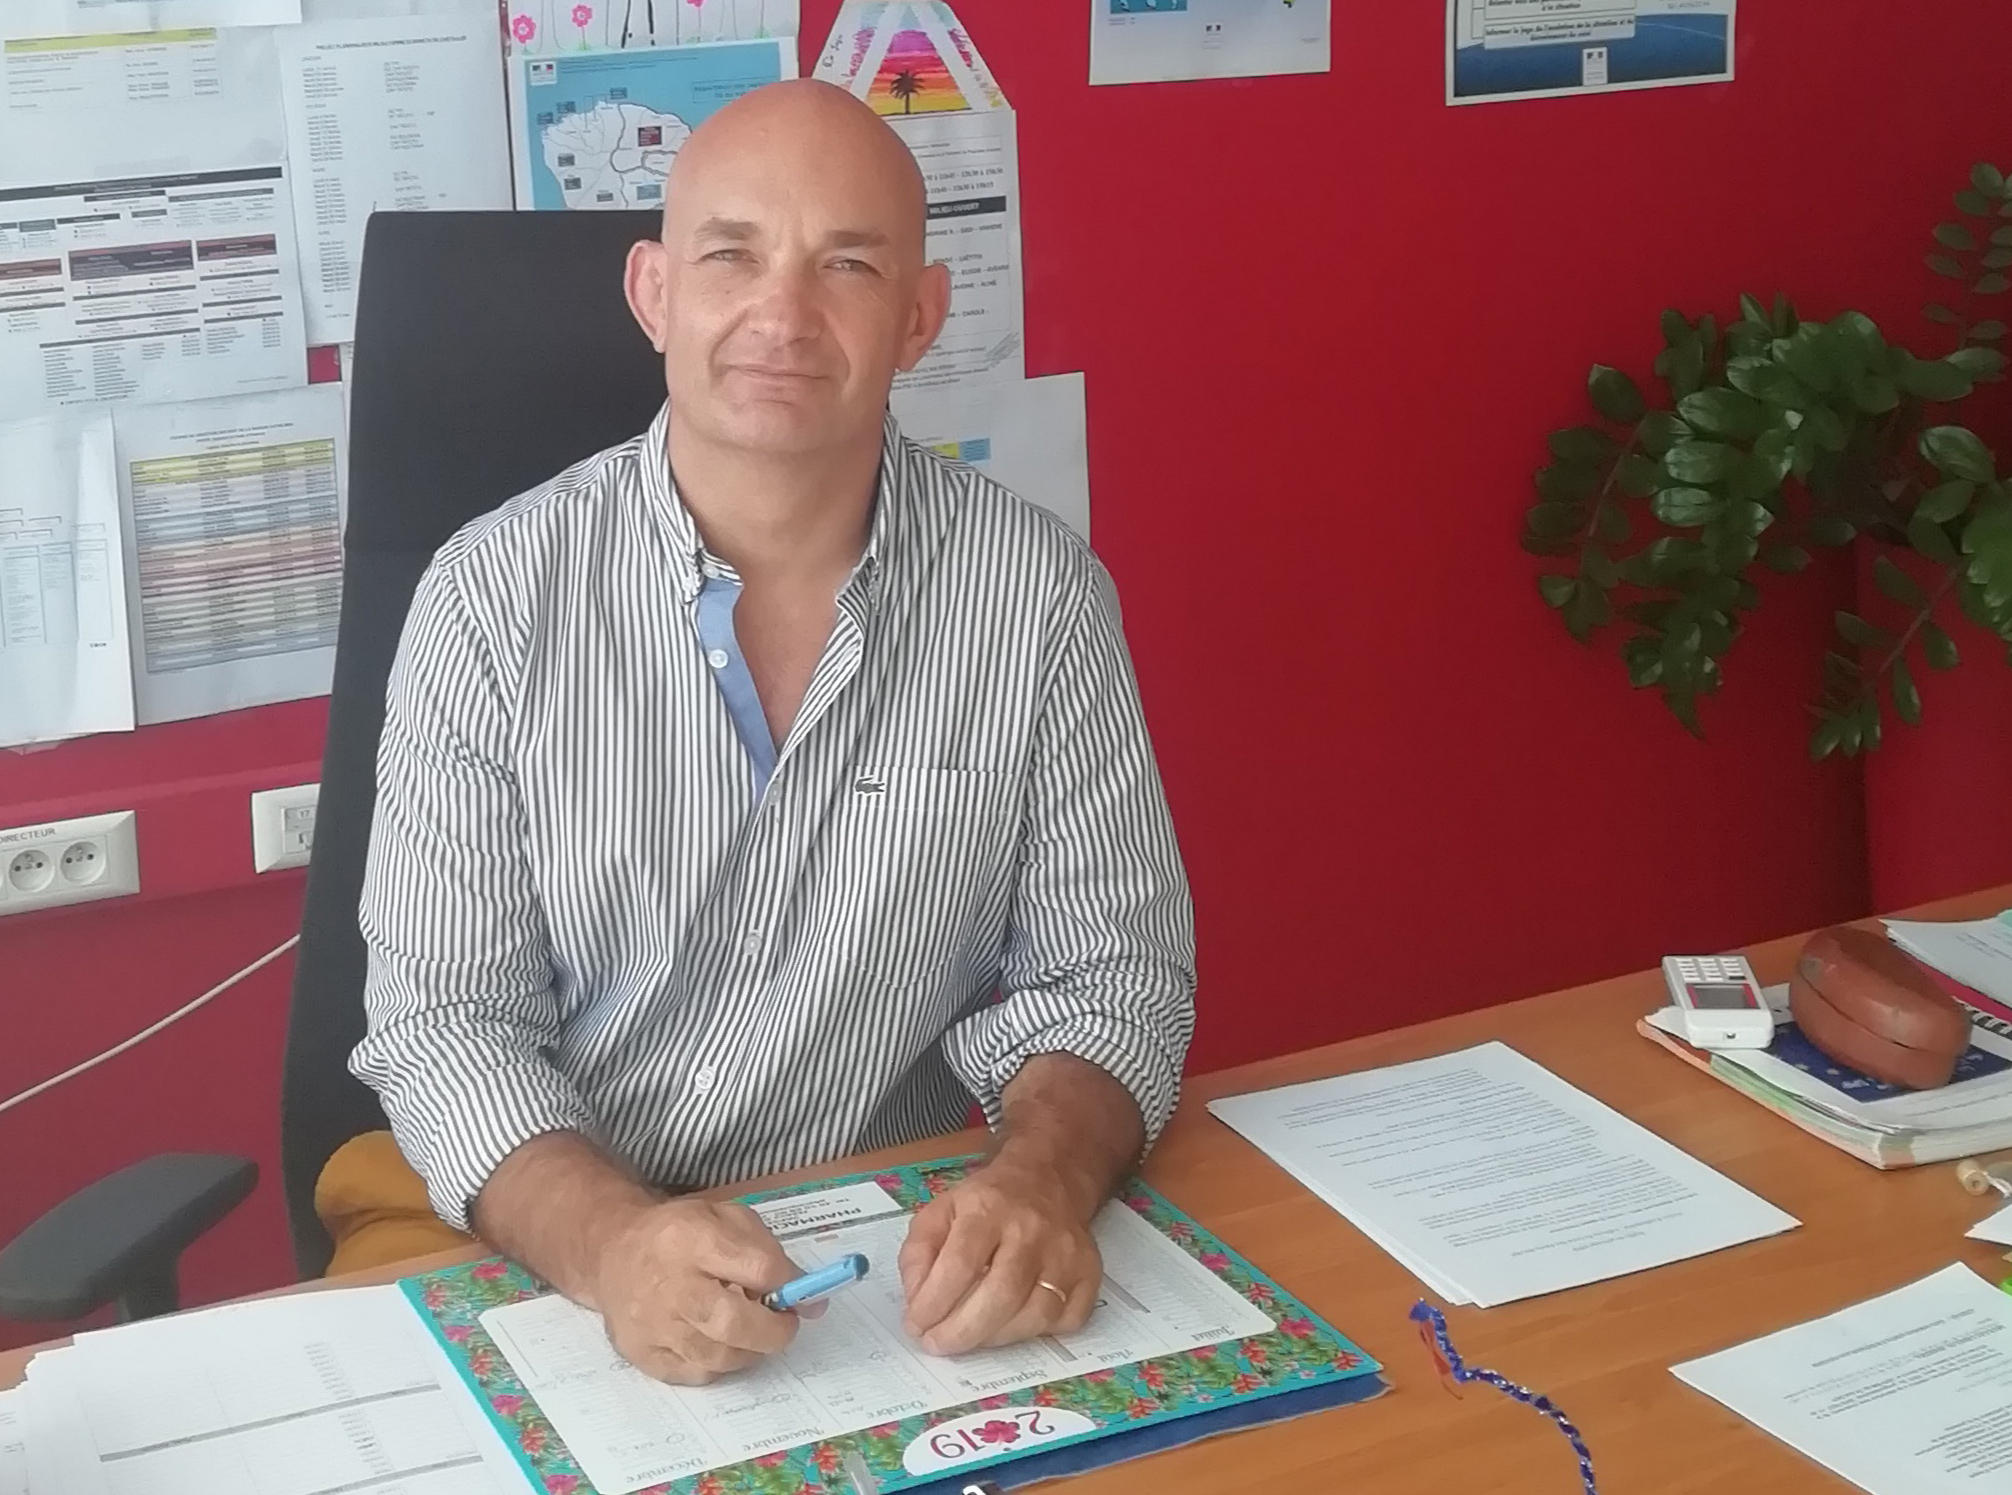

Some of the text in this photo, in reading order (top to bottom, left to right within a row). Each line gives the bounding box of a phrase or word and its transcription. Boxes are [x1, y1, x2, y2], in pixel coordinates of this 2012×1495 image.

[0, 827, 56, 844] DIRECTEUR
[970, 1368, 1049, 1393] Septembre
[866, 1399, 929, 1420] Octobre
[742, 1426, 825, 1452] Novembre
[626, 1457, 708, 1485] Décembre
